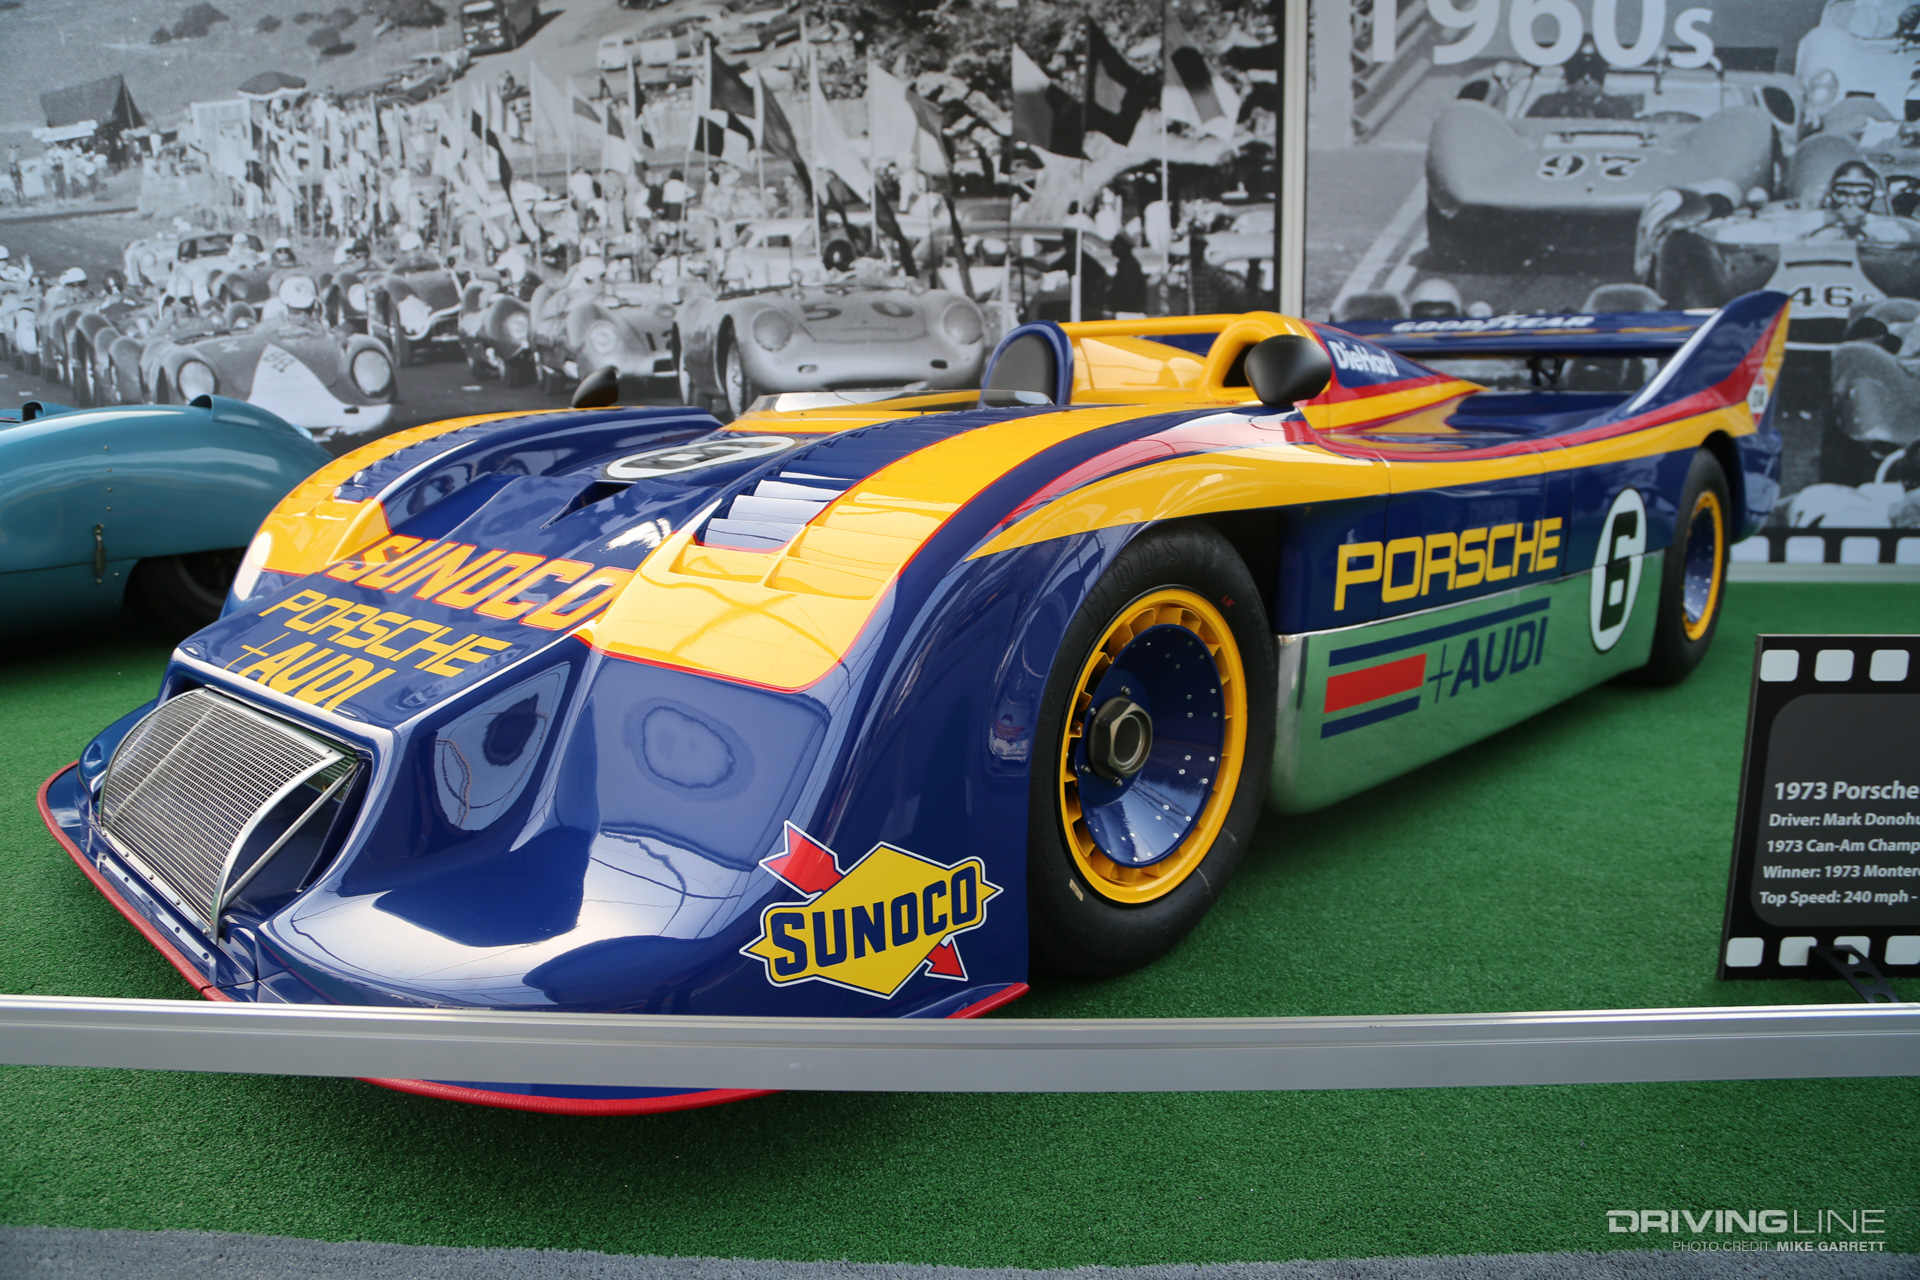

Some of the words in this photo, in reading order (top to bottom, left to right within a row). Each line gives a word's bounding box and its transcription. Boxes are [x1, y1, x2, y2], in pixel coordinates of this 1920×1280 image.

[1372, 0, 1714, 69] 1960s
[1538, 152, 1648, 181] 97
[1327, 340, 1400, 378] DieHard
[322, 533, 638, 632] SUNOCO
[1333, 516, 1563, 612] PORSCHE
[1598, 509, 1640, 634] 6
[258, 588, 514, 679] PORSCHE
[1774, 782, 1828, 800] 1973
[1832, 780, 1920, 800] Porsche
[1768, 813, 1821, 827] Driver:
[1822, 812, 1862, 826] Mark
[1766, 839, 1803, 852] 1973
[1805, 839, 1865, 852] Can-Am
[1762, 865, 1821, 878] Winner:
[1824, 865, 1861, 878] 1973
[1759, 891, 1787, 907] Top
[1789, 890, 1841, 907] Speed:
[1843, 890, 1872, 903] 240
[1873, 889, 1909, 906] mph
[770, 865, 978, 978] SUNOCO
